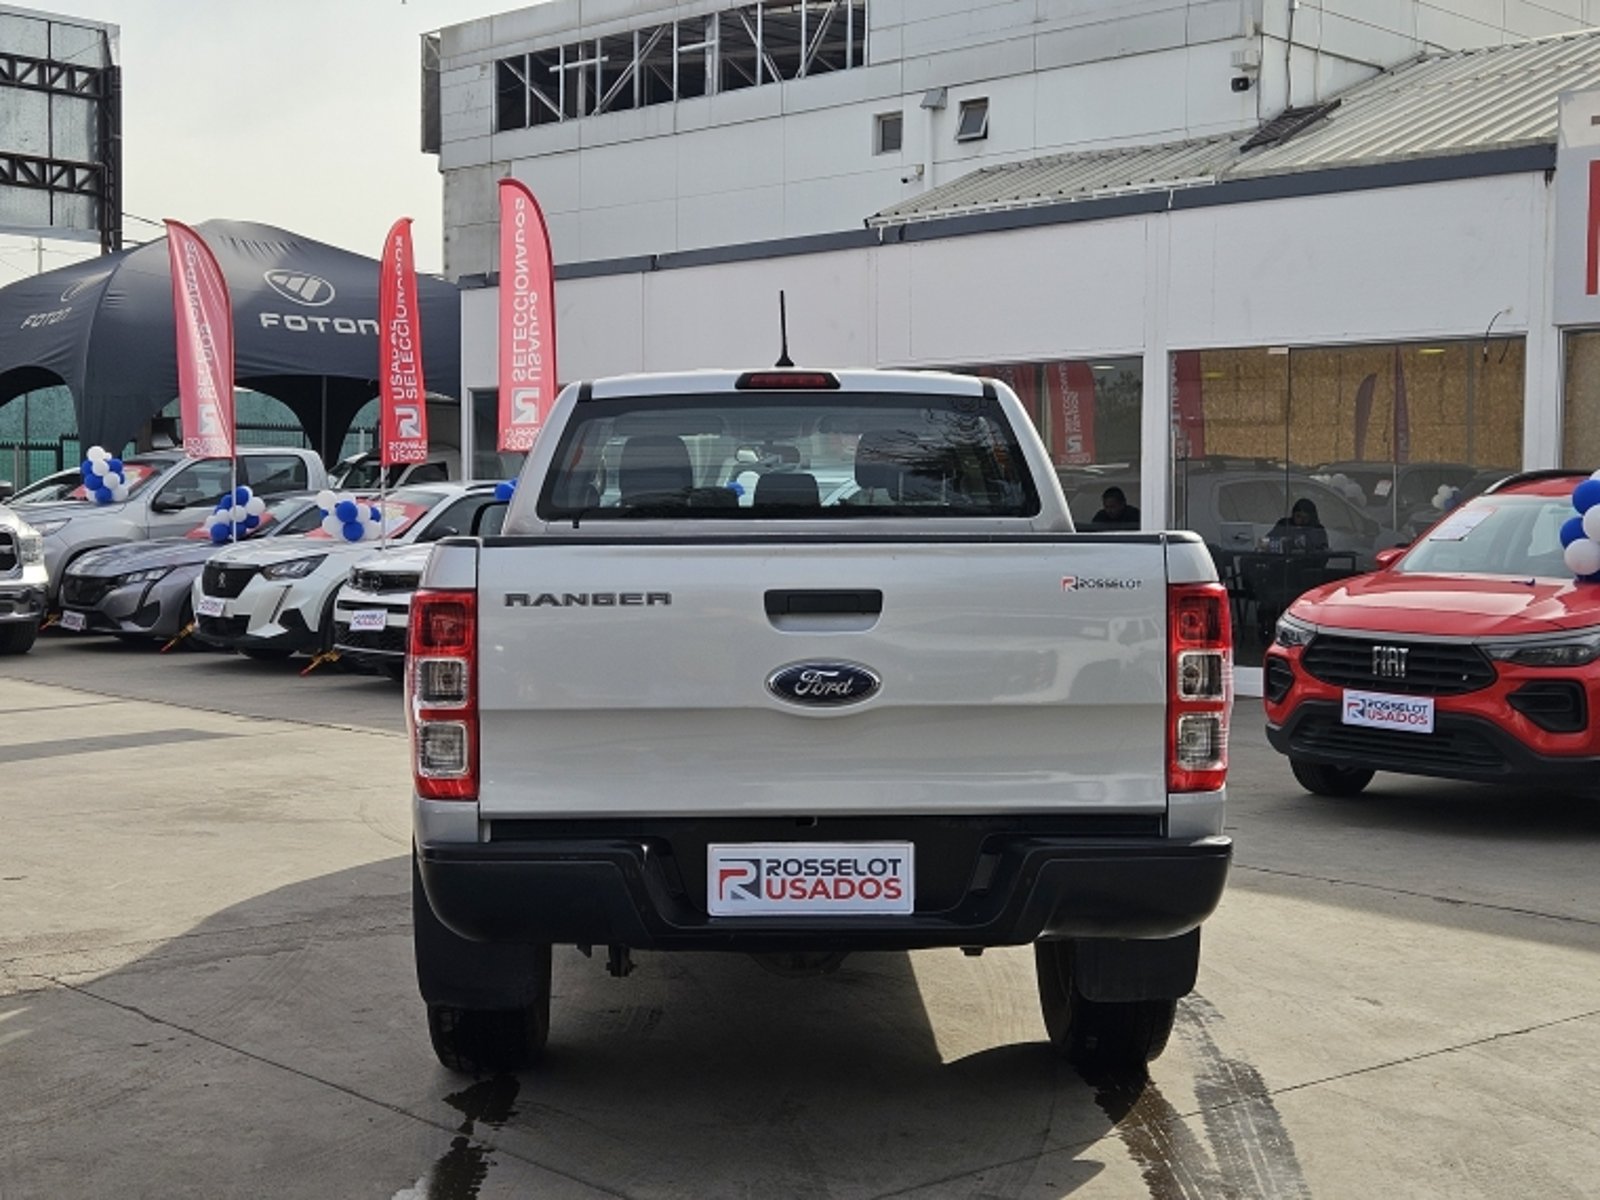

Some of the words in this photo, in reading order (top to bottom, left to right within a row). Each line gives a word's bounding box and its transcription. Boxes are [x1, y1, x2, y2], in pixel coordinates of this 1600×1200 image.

[259, 313, 379, 335] FOTON
[1080, 578, 1142, 588] ROSSELOT
[504, 592, 672, 607] RANGER
[1373, 645, 1409, 678] FIAT
[795, 669, 853, 696] Ford
[1367, 700, 1428, 714] ROSSELOT
[1367, 709, 1428, 725] USADOS
[766, 858, 902, 876] ROSSELOT
[766, 878, 902, 900] USADOS
